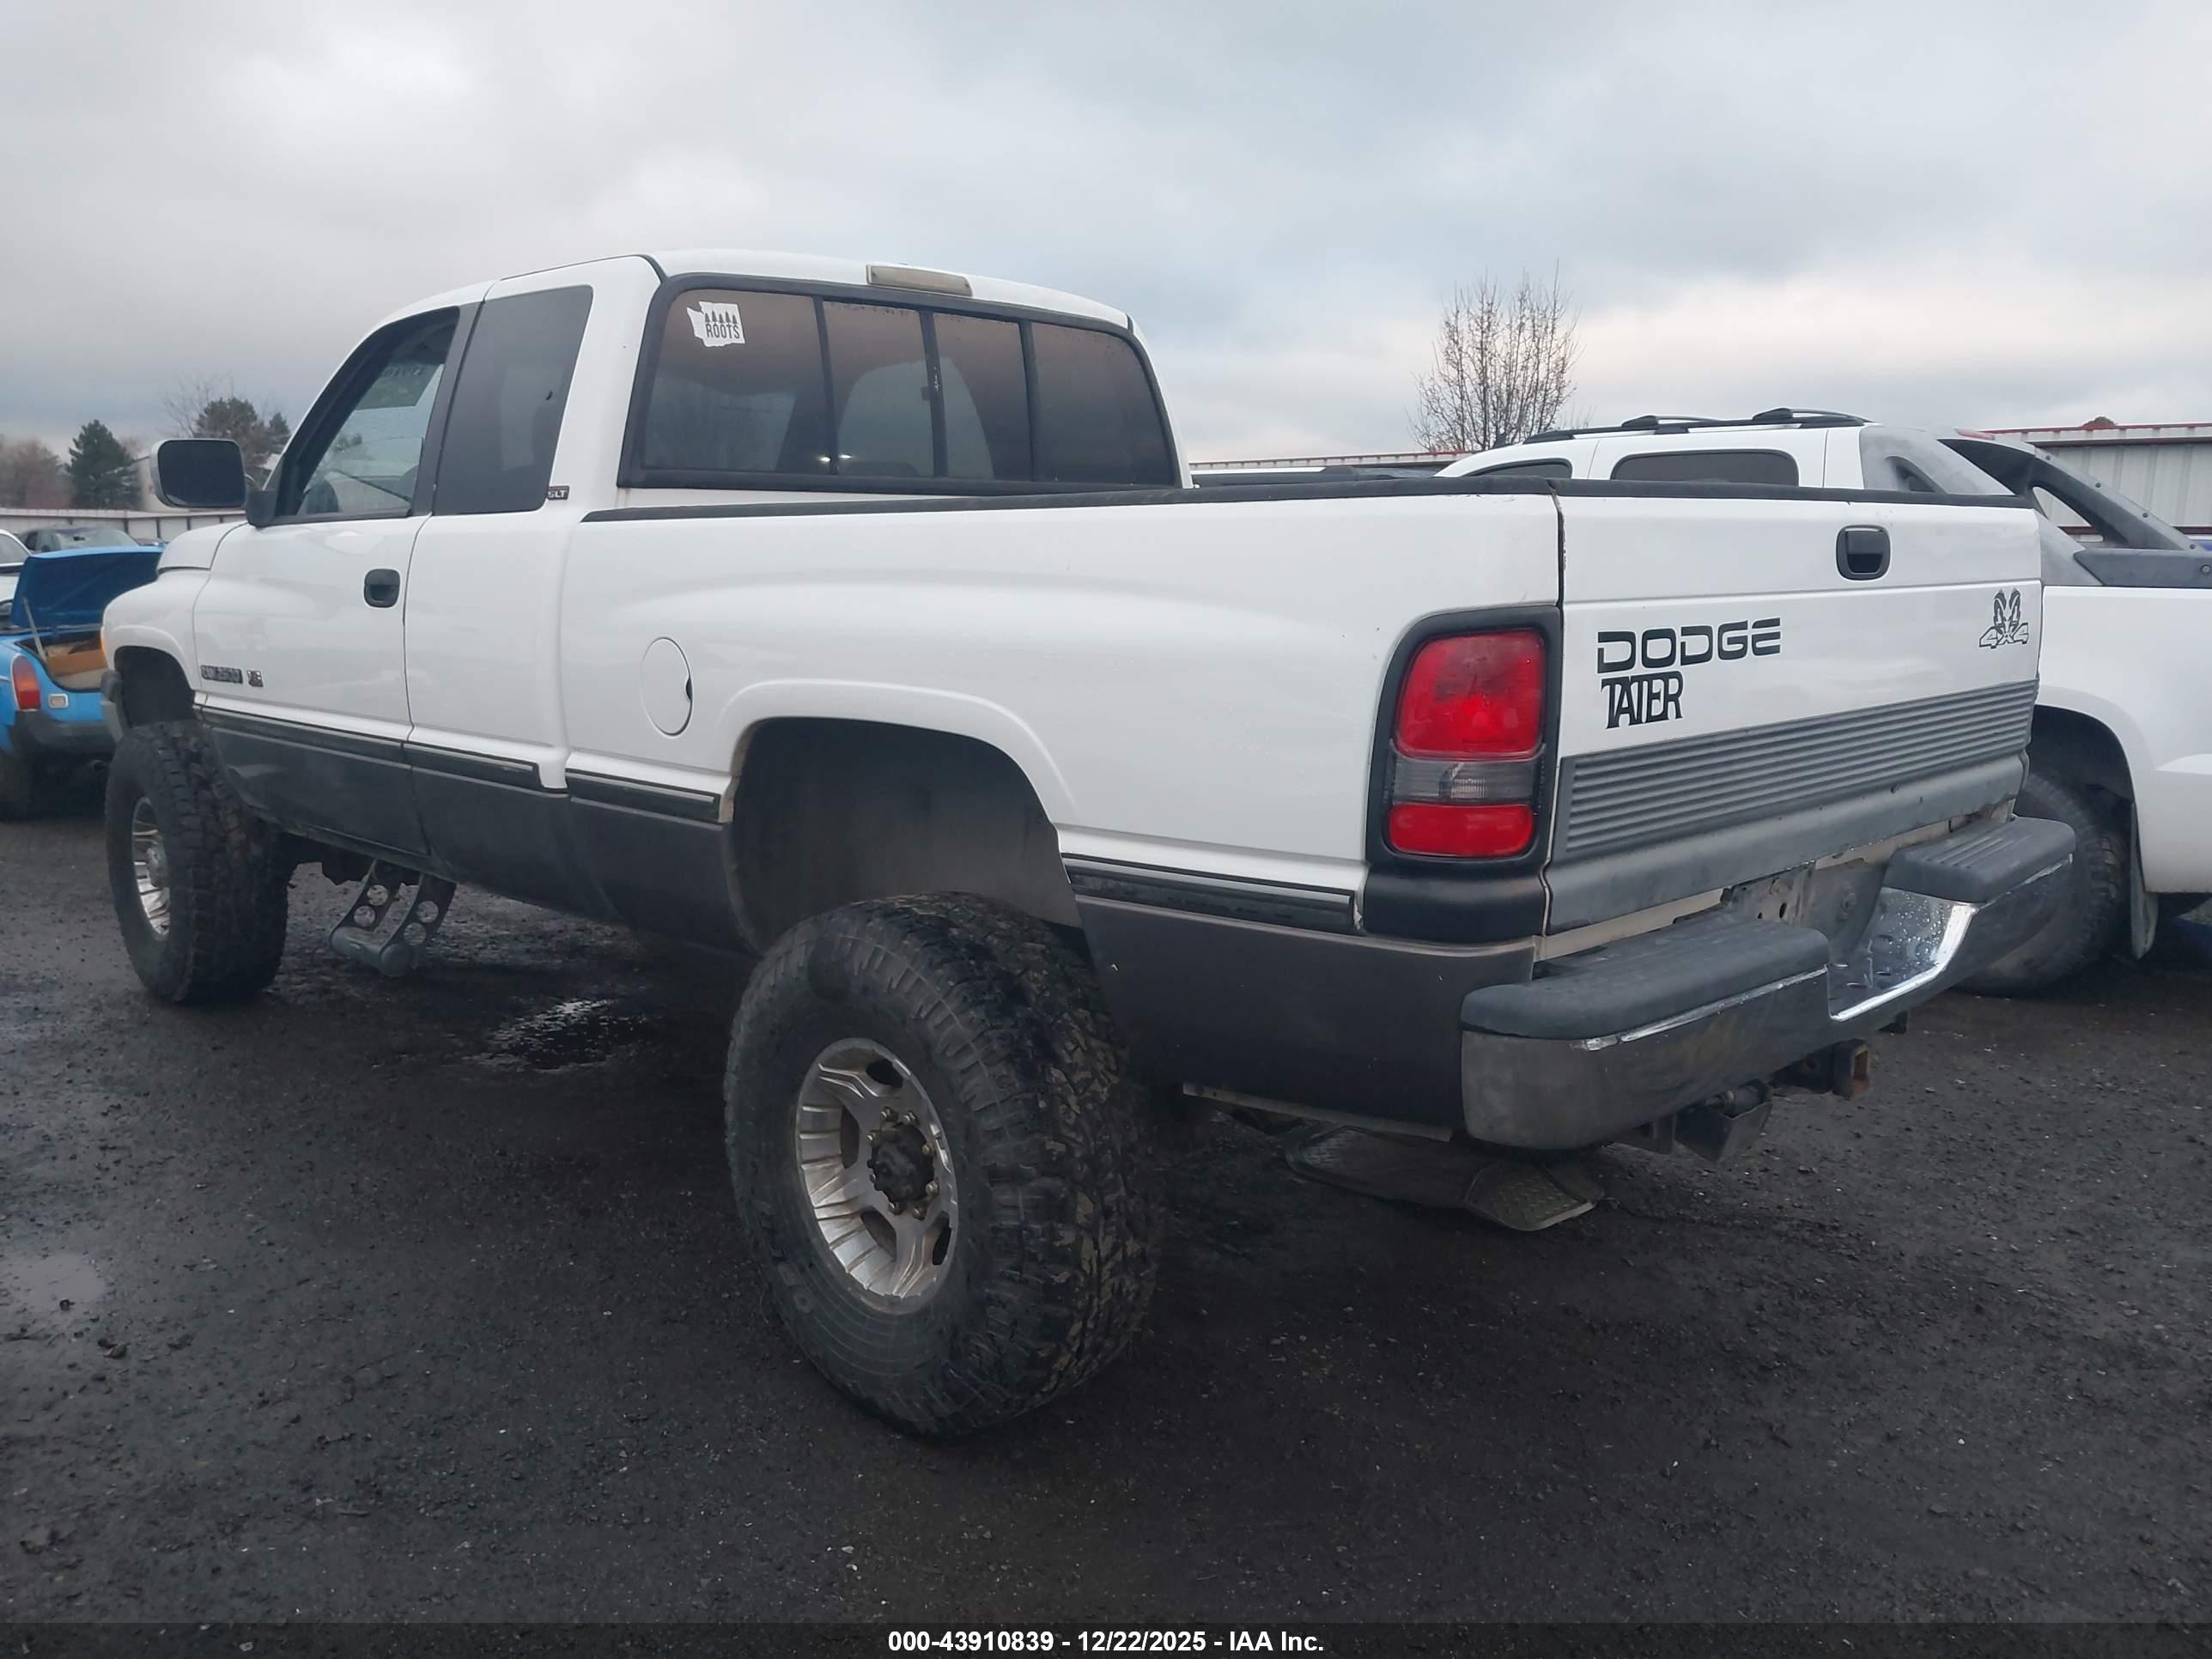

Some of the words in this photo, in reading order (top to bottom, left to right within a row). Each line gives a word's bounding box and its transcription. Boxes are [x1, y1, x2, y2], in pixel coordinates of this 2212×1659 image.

[705, 323, 740, 339] ROOTS
[1597, 617, 1781, 673] DODGE
[1601, 671, 1683, 729] TATER
